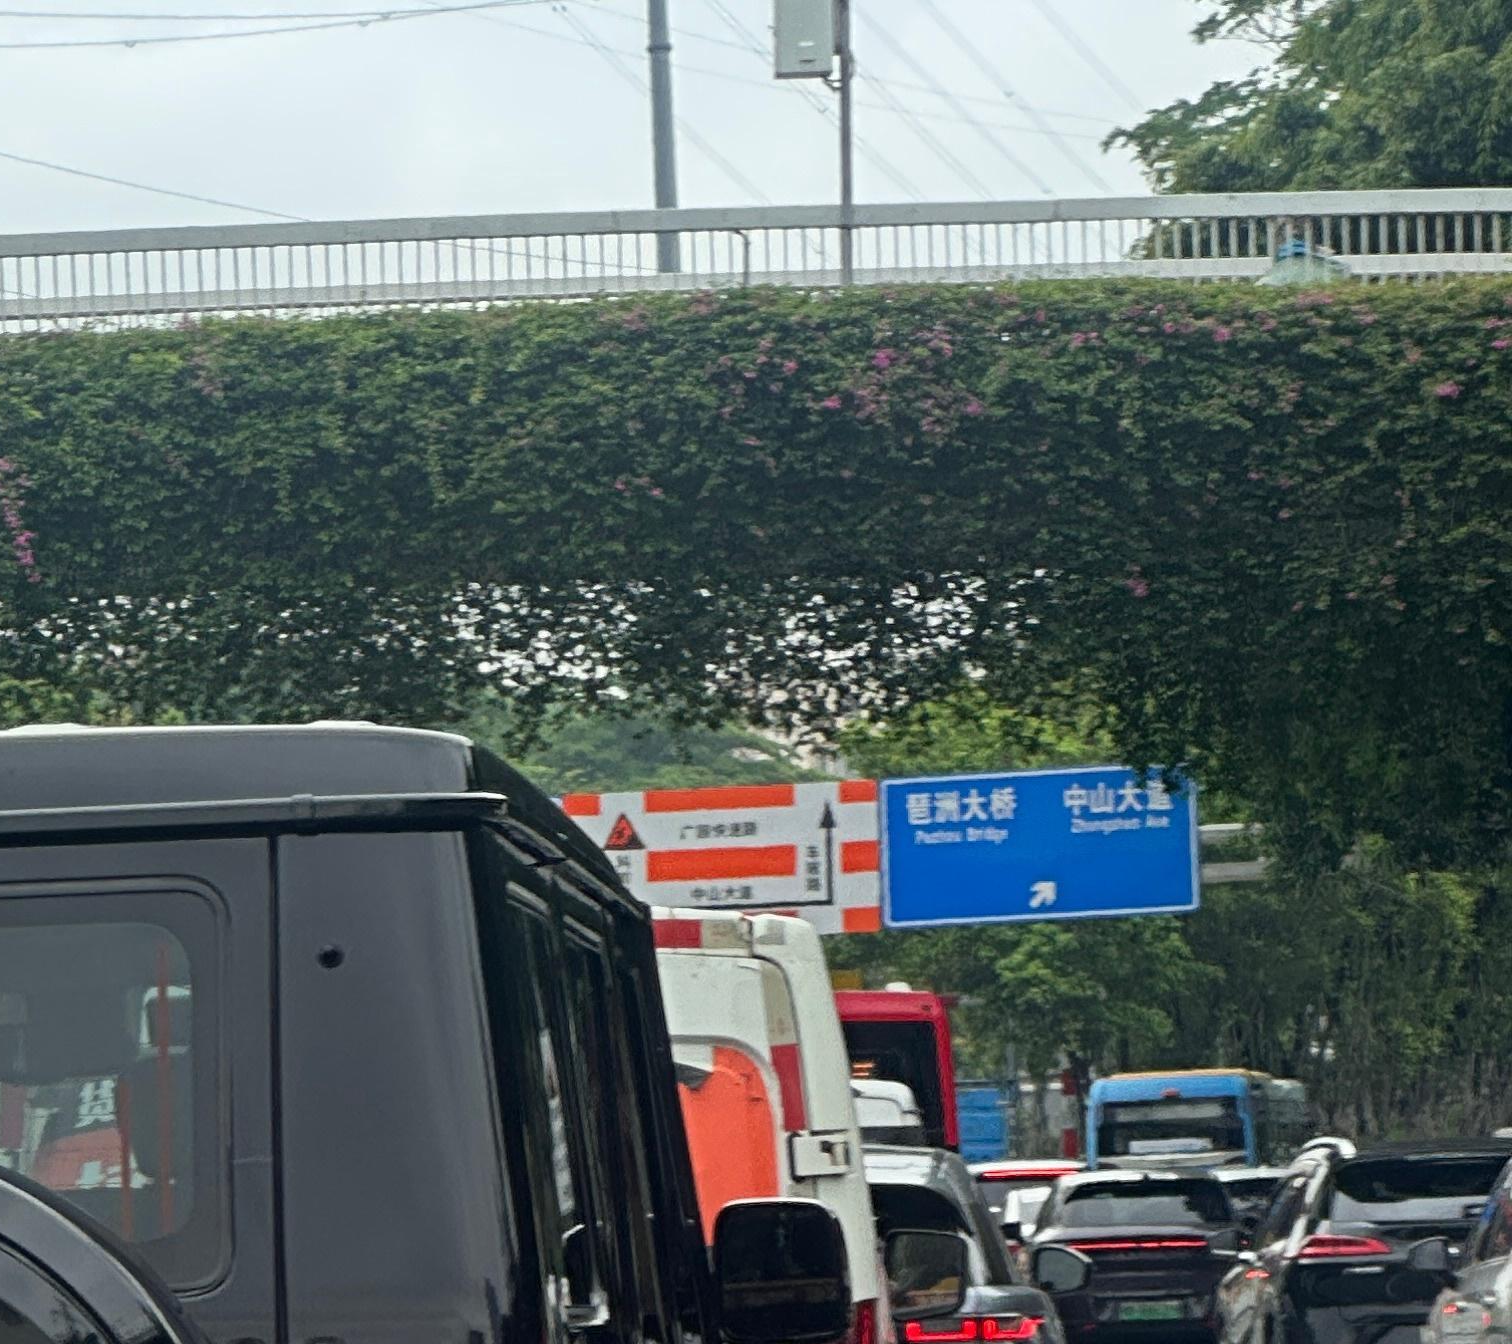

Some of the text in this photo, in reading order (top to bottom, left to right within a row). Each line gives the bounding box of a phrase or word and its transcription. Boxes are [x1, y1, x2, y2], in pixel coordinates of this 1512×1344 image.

[906, 786, 1017, 825] 琶洲大桥
[1063, 780, 1175, 816] 中山大道
